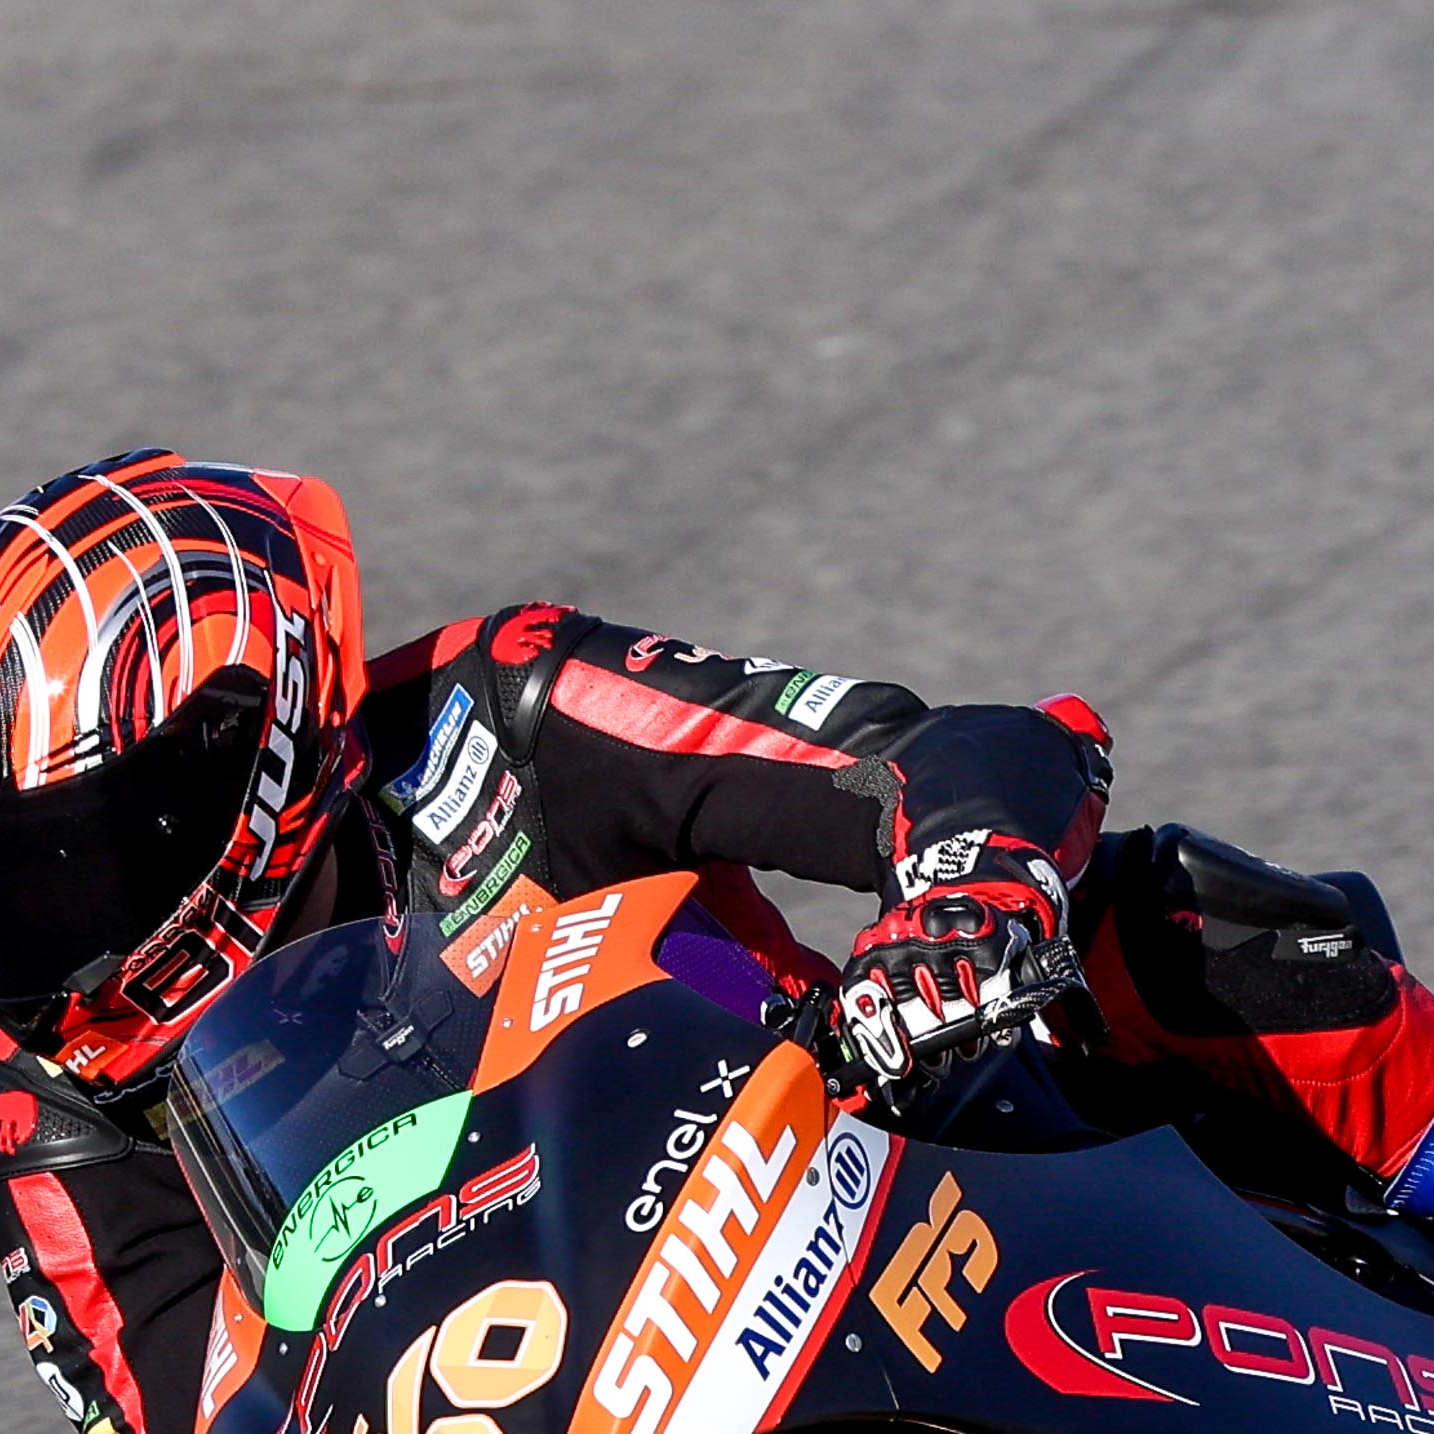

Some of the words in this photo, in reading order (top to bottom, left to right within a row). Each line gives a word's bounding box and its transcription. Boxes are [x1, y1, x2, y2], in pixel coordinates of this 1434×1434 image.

[428, 765, 477, 831] Allianz
[530, 893, 624, 1032] STIHL
[626, 1108, 718, 1232] enel
[734, 1200, 844, 1382] Allianz
